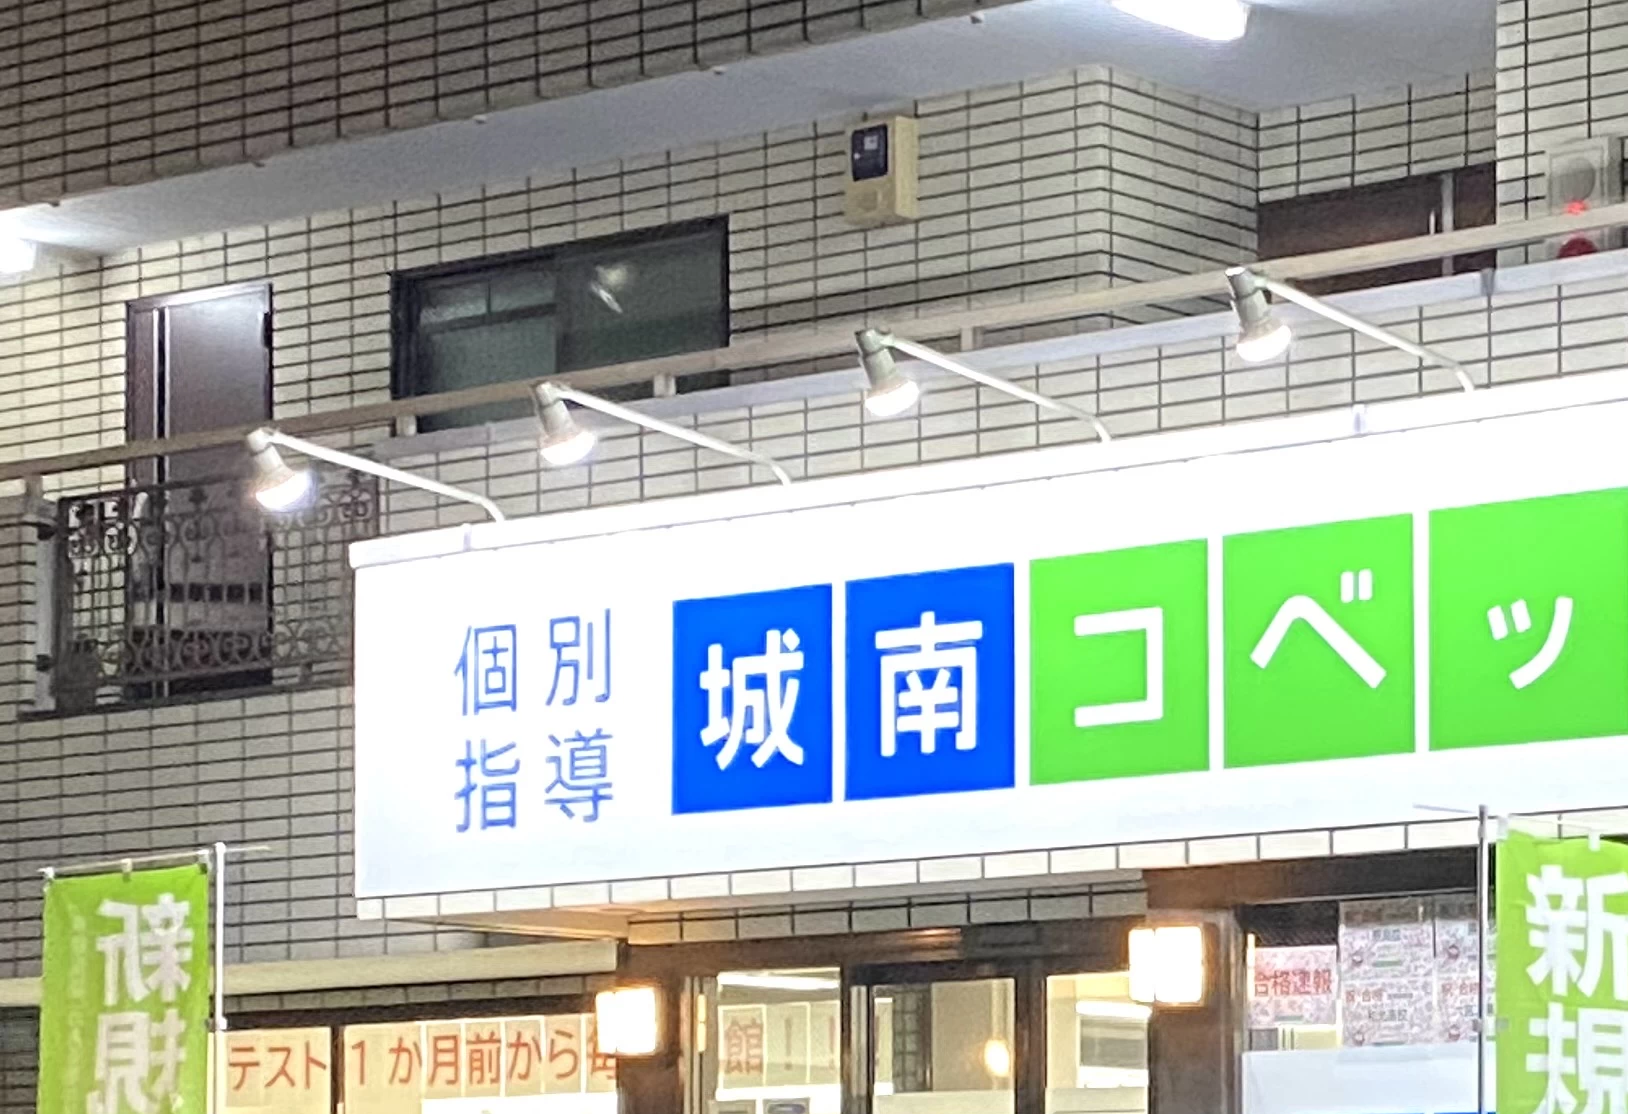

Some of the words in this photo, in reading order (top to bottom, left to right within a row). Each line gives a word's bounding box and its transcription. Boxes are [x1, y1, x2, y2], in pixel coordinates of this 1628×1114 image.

[453, 608, 612, 717] 個別
[454, 728, 614, 833] 指導
[1254, 969, 1333, 996] 合格速報
[229, 1040, 327, 1091] テスト
